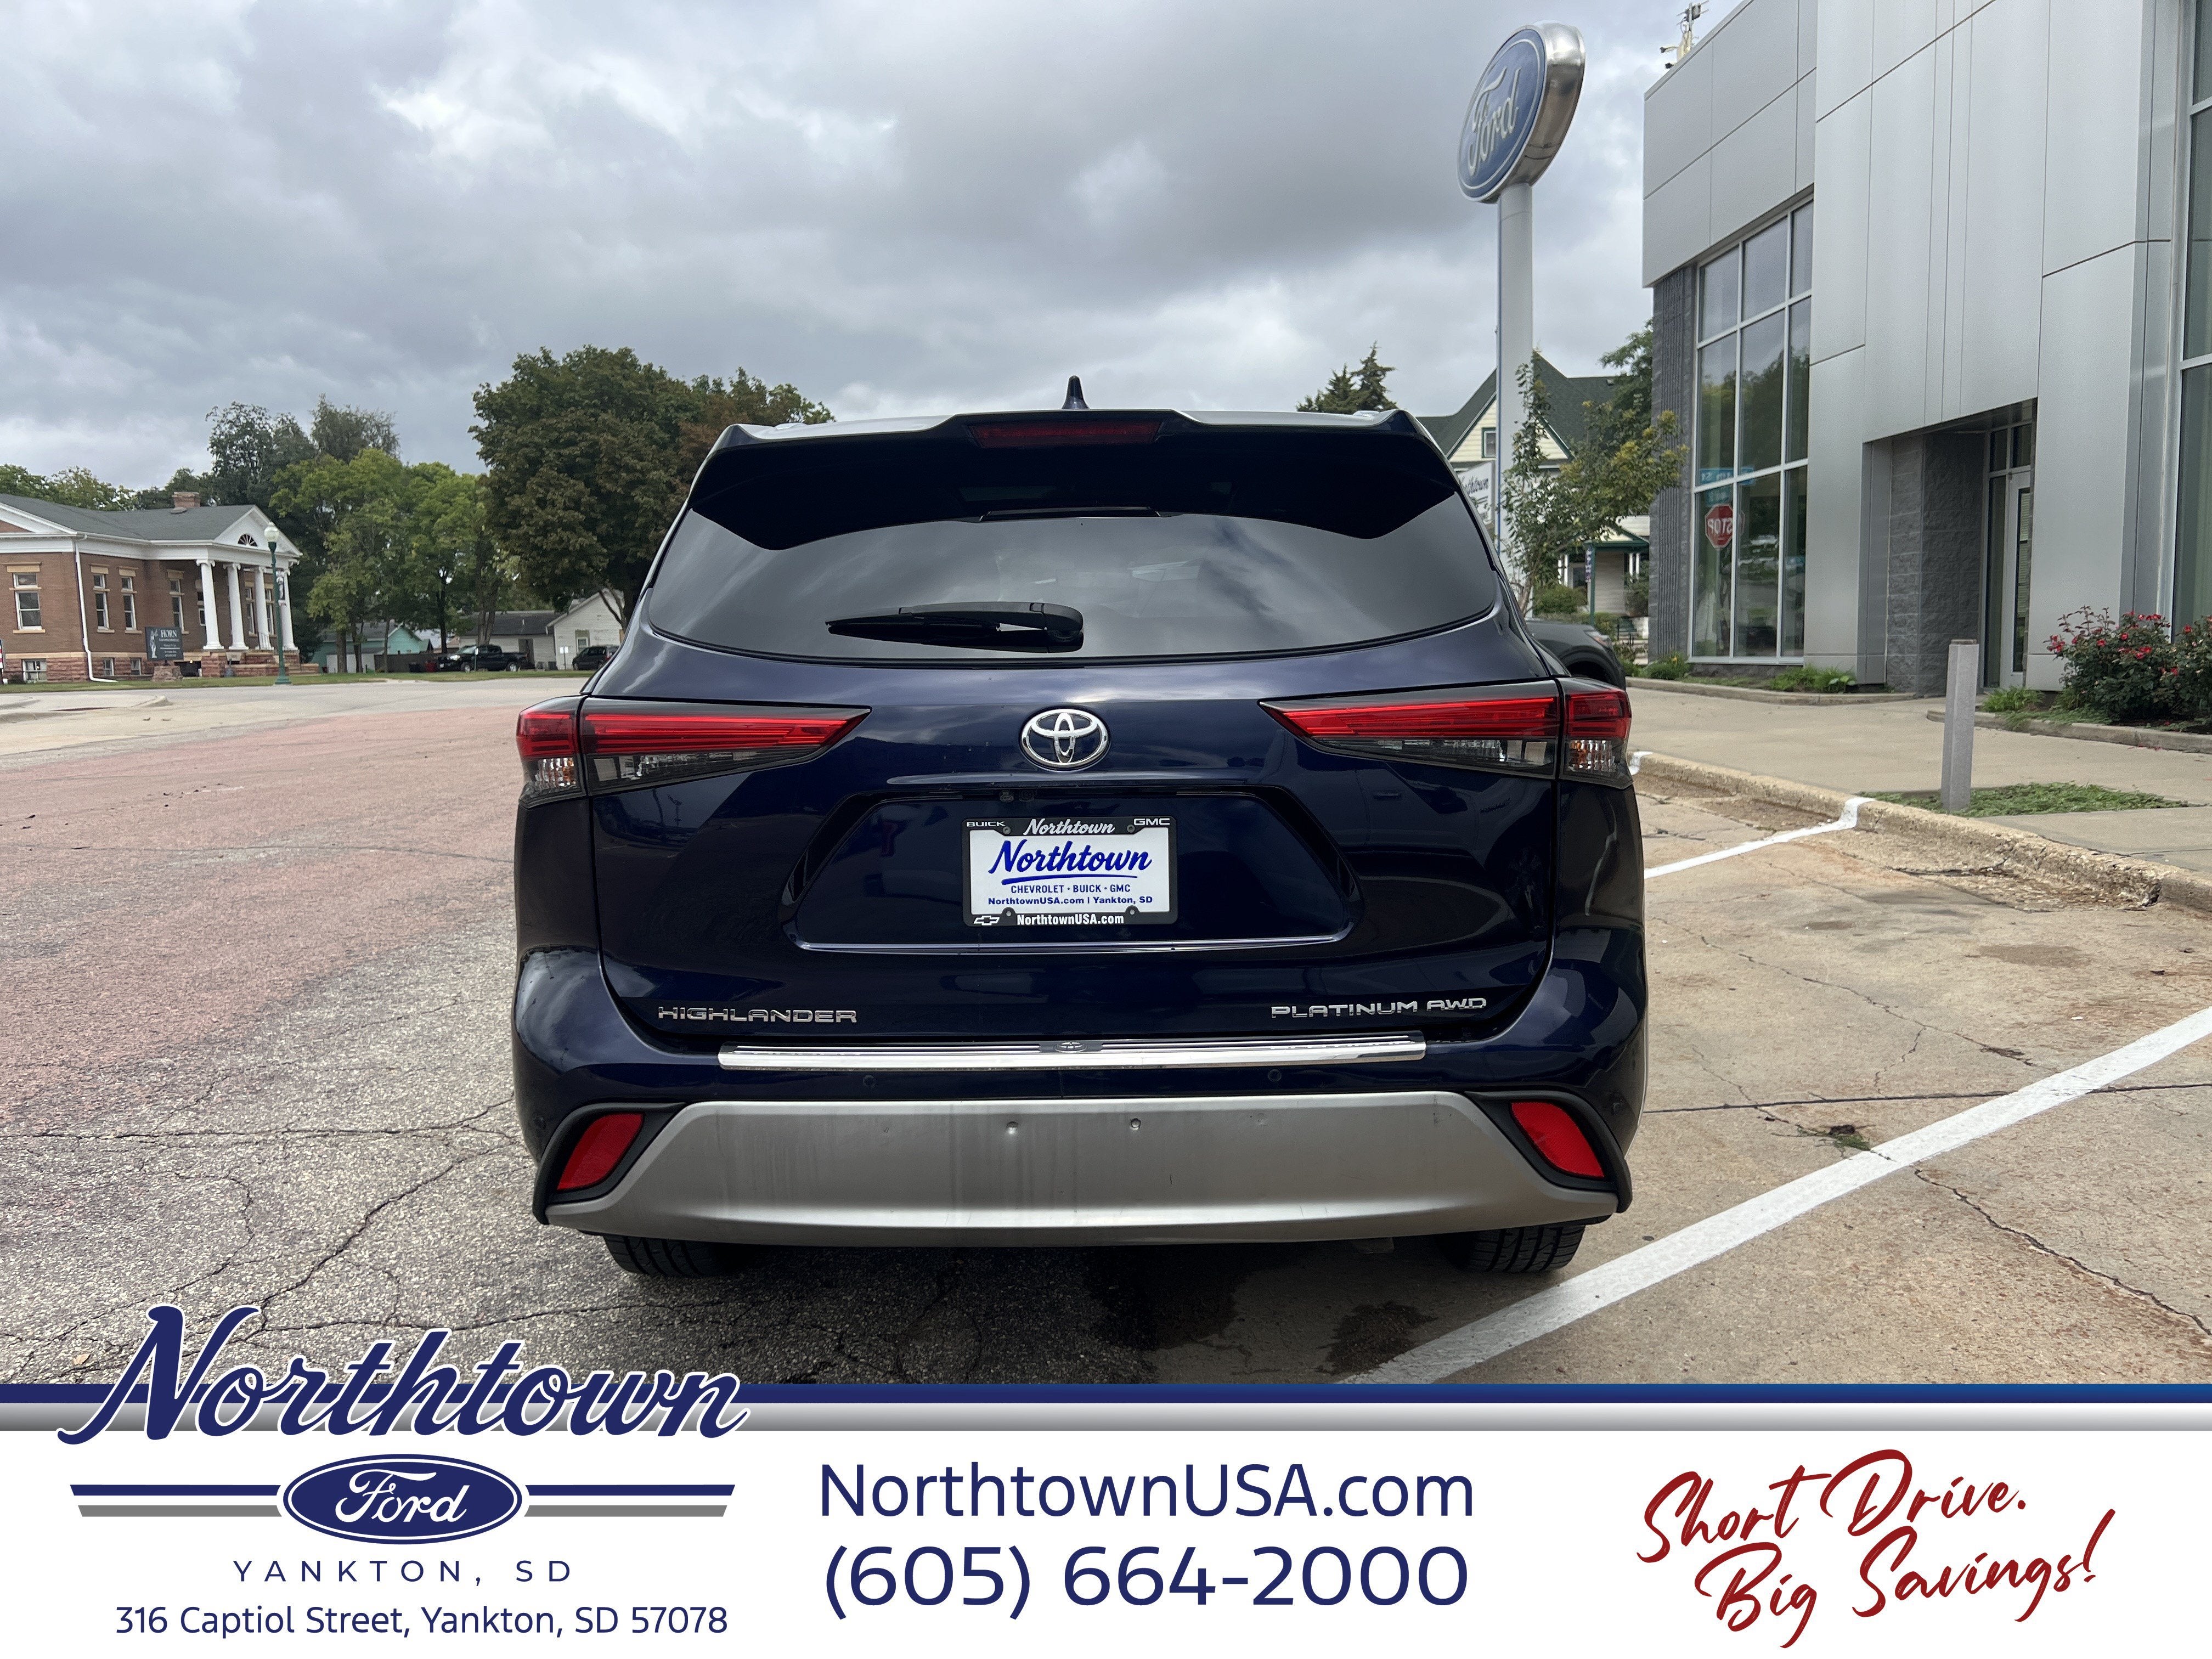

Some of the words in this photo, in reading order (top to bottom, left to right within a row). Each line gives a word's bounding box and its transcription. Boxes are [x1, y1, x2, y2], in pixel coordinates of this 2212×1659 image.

[1468, 66, 1522, 177] Ford
[161, 629, 177, 638] HORN
[1023, 818, 1115, 836] Northtown
[1133, 817, 1170, 826] GMC
[988, 839, 1152, 874] Northtown
[1011, 884, 1064, 894] CHEVROLET
[1073, 884, 1102, 893] BUICK
[1109, 883, 1131, 893] GMC
[988, 896, 1085, 905] NorthtownUSA.com
[1093, 896, 1136, 905] Yankton,
[1017, 913, 1124, 926] NorthtownUSA.com
[658, 1006, 857, 1023] HIGHLANDER
[1271, 1001, 1418, 1018] PLATINUM
[1426, 997, 1487, 1012] AWD
